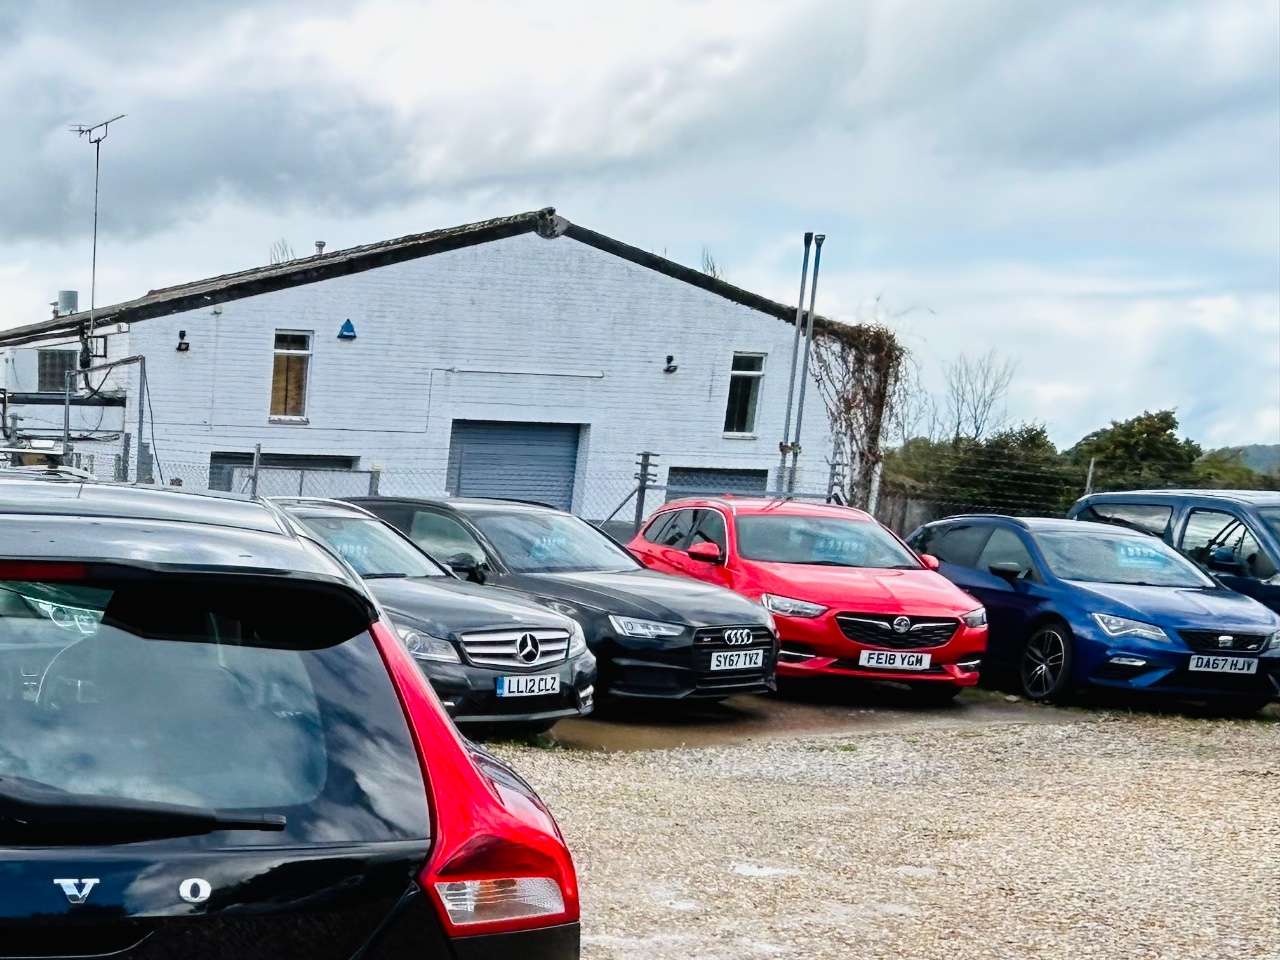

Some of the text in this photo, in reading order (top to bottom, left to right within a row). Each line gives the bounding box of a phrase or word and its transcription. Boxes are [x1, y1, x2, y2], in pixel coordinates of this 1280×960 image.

[716, 654, 740, 668] SY67
[866, 652, 897, 665] FE18
[1195, 656, 1228, 670] DA67
